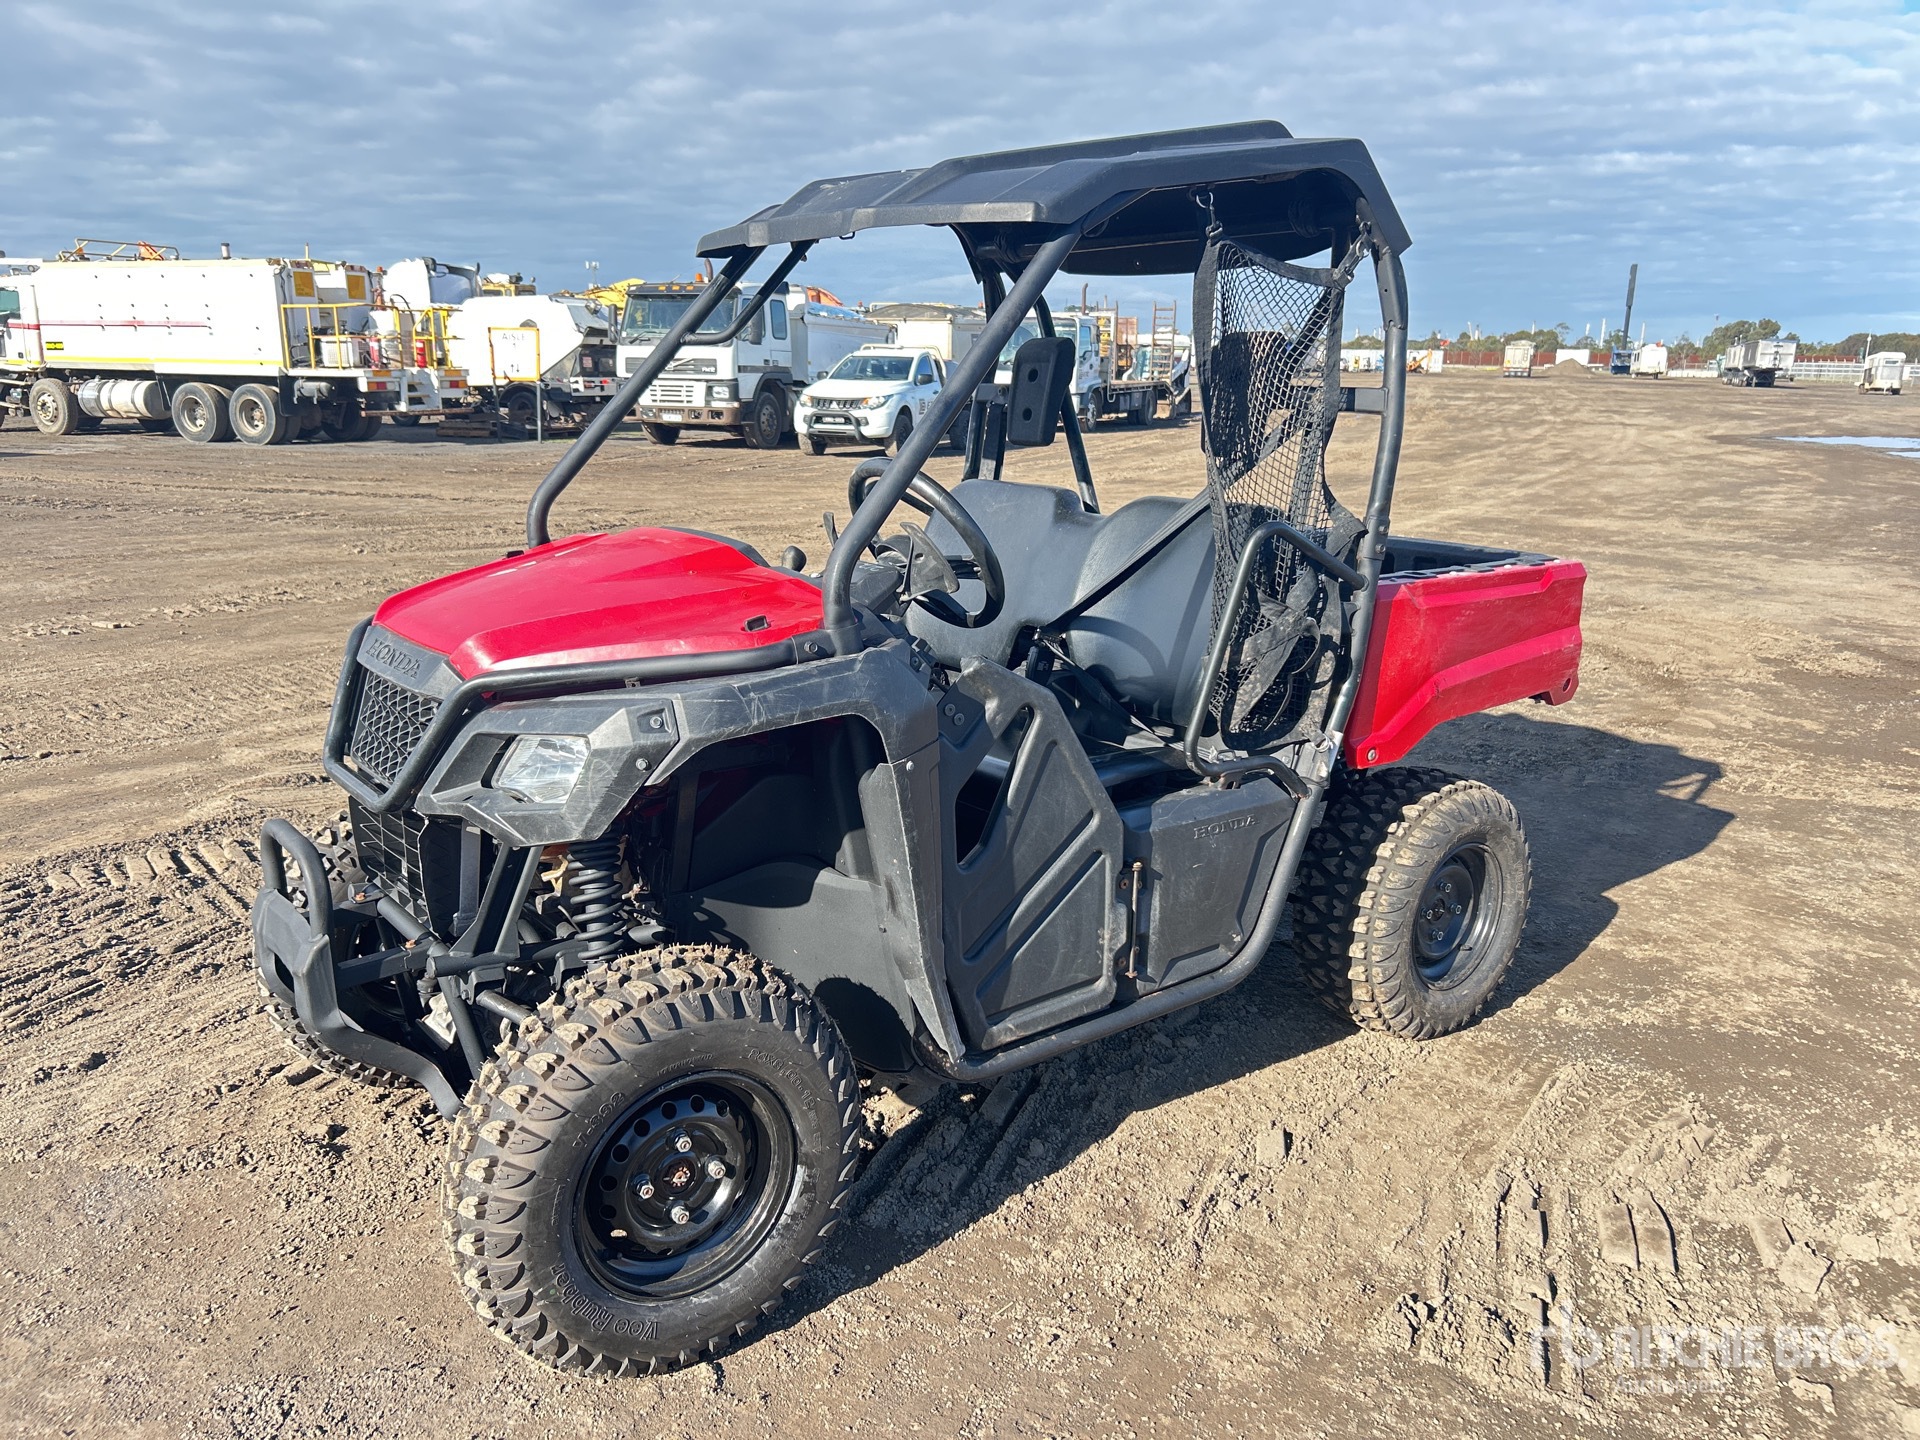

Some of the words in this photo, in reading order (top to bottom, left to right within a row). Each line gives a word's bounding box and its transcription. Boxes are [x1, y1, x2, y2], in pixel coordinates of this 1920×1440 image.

[502, 332, 526, 341] AISLE
[366, 638, 421, 679] HONDA
[1193, 814, 1257, 839] HONDA
[550, 1262, 615, 1332] Rubber
[613, 1318, 658, 1341] Vee
